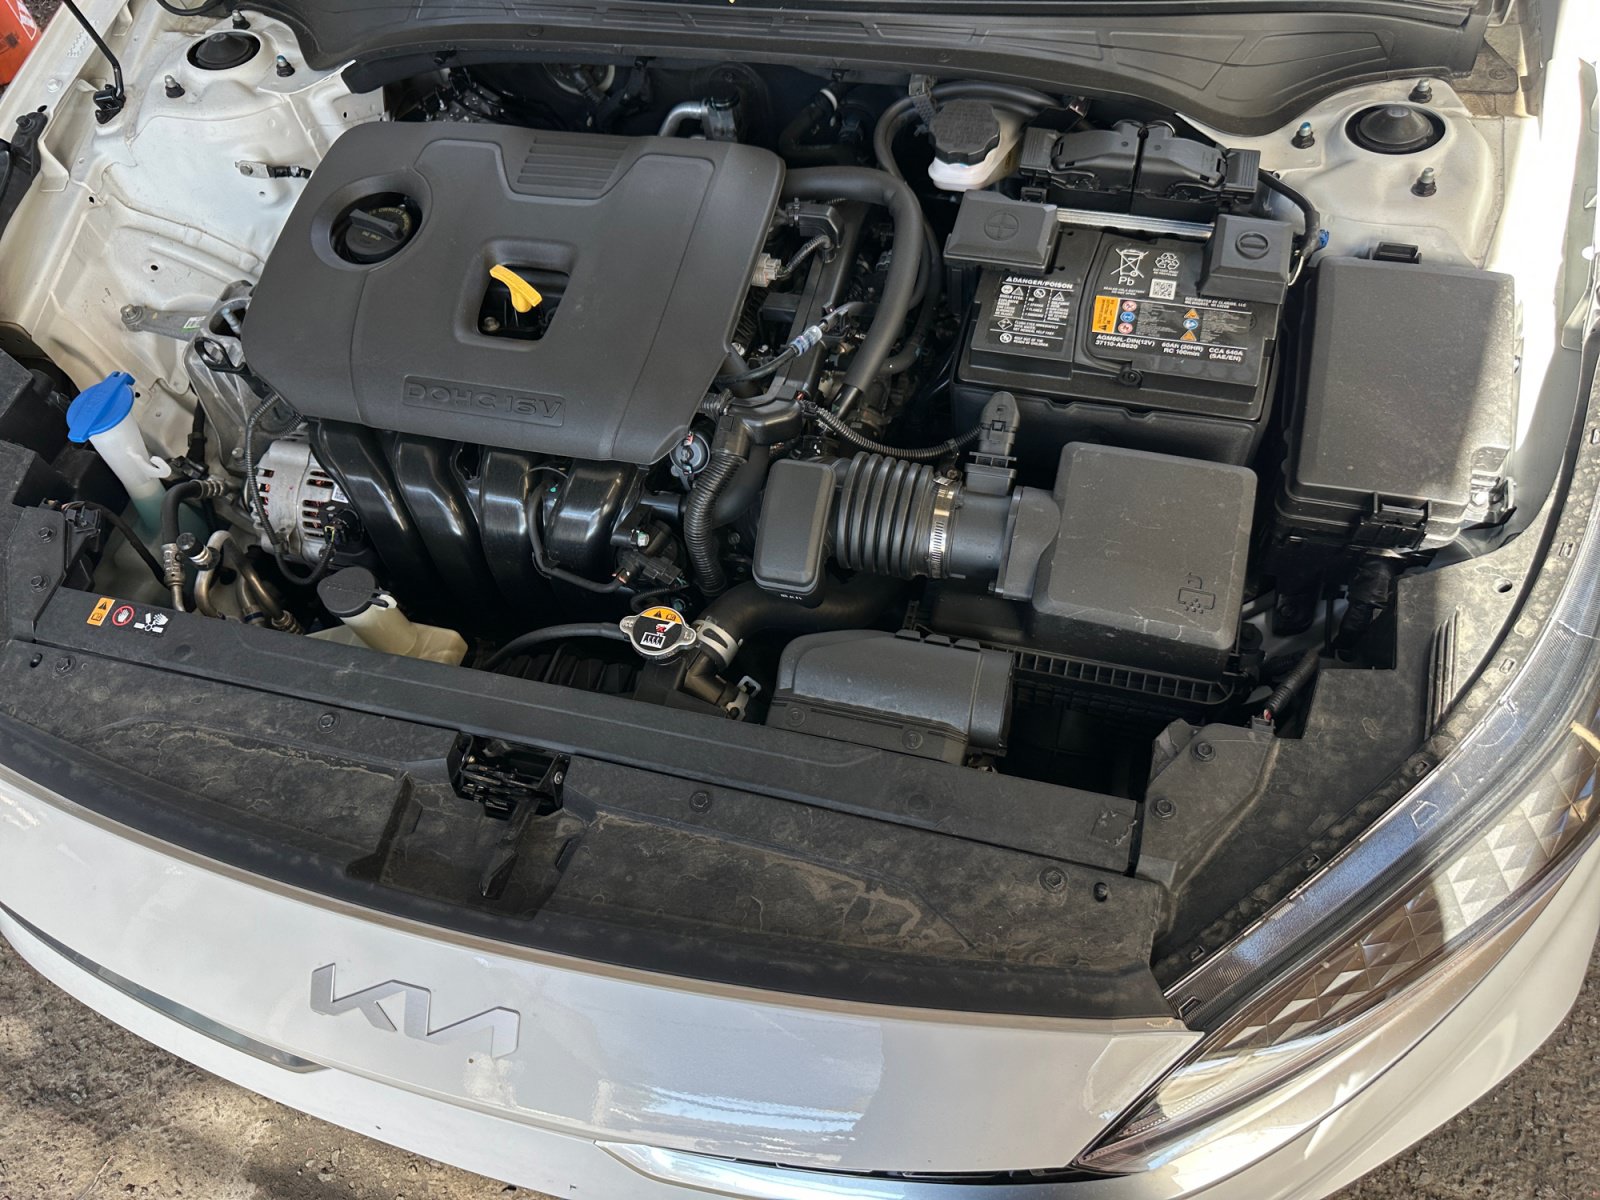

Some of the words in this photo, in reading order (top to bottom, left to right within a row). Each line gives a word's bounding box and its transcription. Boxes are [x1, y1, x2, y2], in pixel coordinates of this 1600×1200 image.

[1012, 277, 1073, 289] DANGER/POISON
[1118, 276, 1135, 286] Pb
[1180, 343, 1204, 352] (20HR)
[1209, 353, 1242, 362] (SAE/EN)
[407, 382, 498, 409] DOHC
[504, 394, 562, 419] 16V
